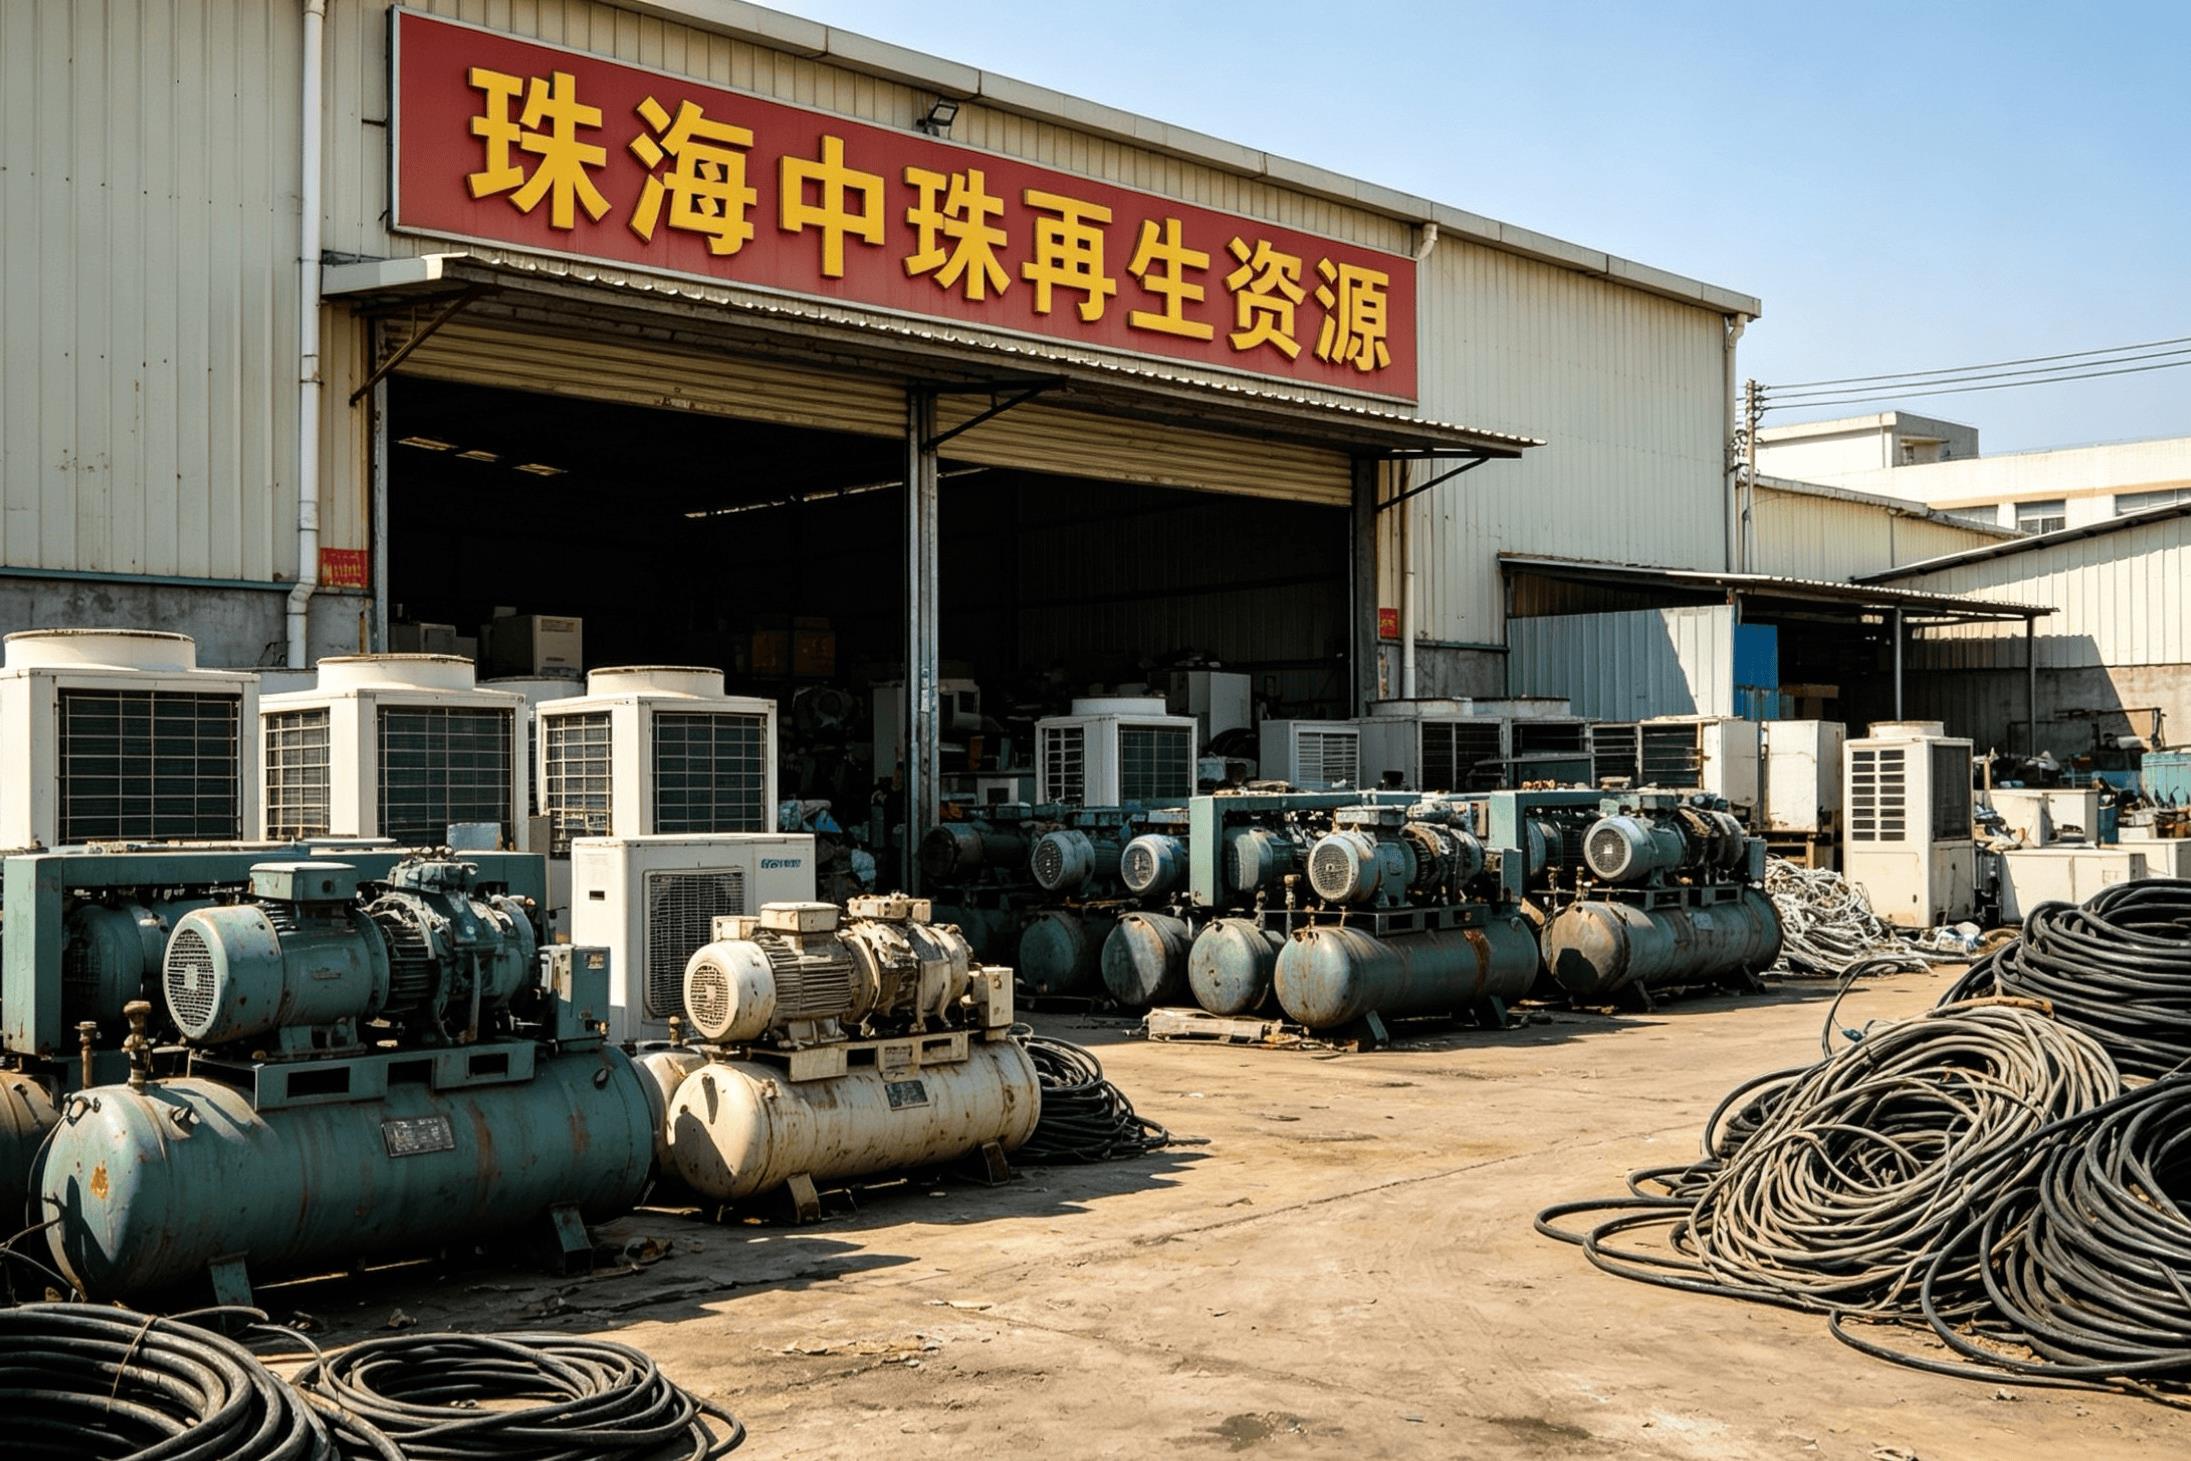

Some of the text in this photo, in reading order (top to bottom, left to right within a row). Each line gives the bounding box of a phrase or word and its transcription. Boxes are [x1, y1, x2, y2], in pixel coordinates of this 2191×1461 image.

[467, 67, 1392, 371] 珠海中珠再生资源
